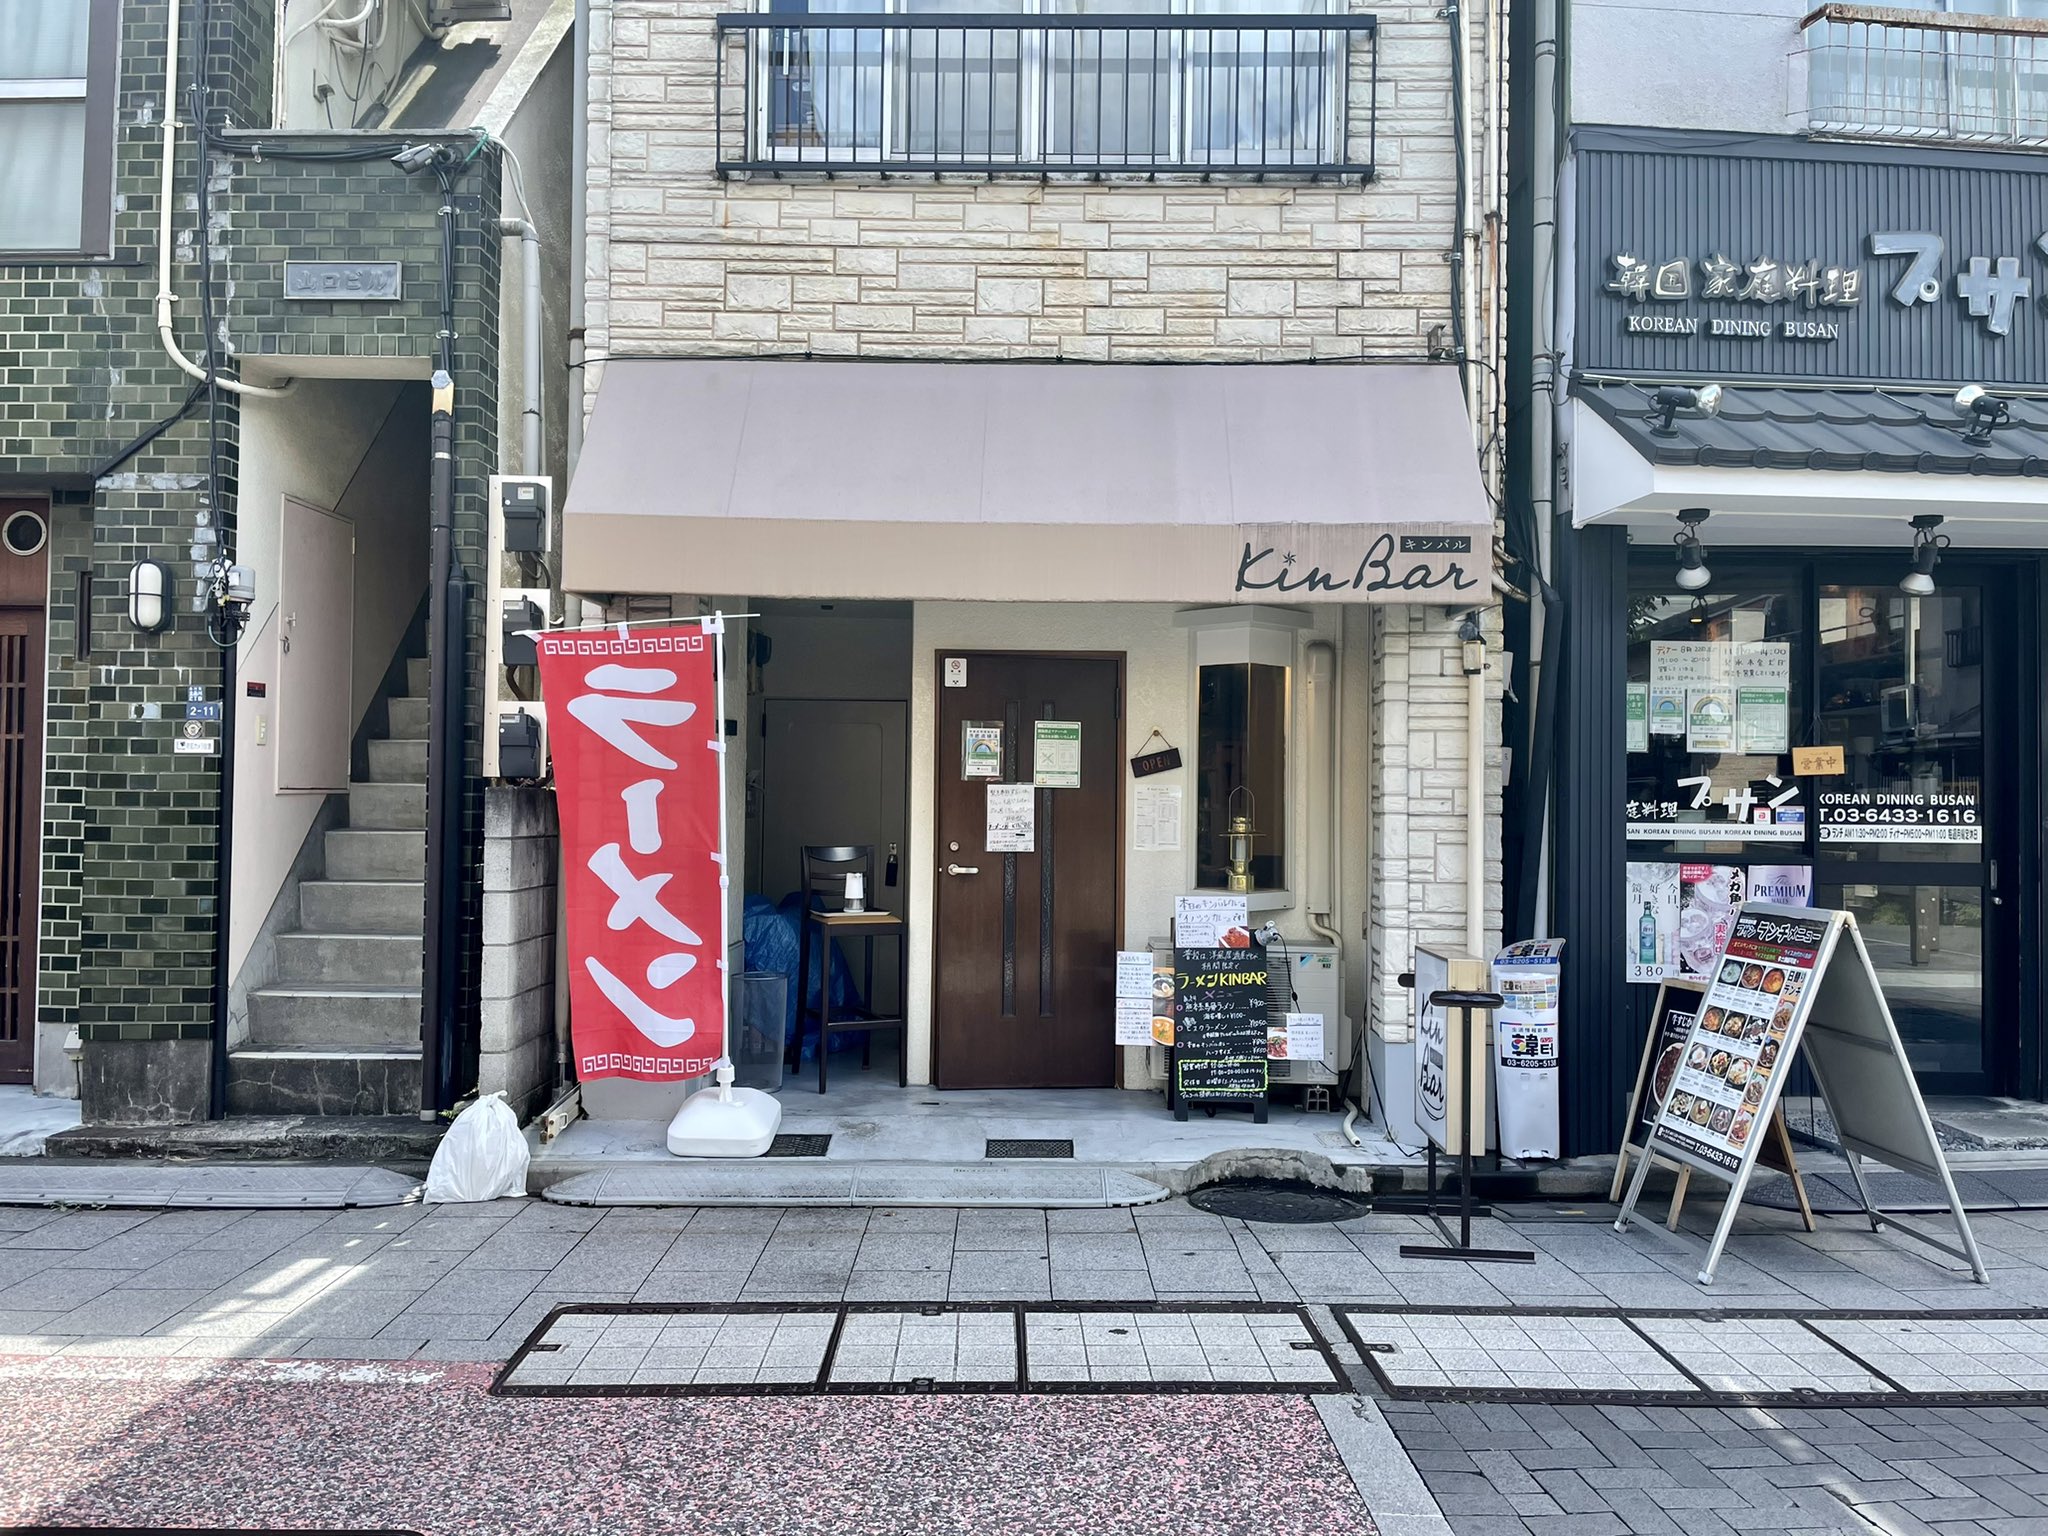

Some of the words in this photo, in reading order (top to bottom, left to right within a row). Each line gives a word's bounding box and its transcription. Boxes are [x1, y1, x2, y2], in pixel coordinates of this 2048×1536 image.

[296, 270, 389, 292] 山口ビル
[1607, 251, 1863, 309] 韓国家庭料理
[1628, 315, 1699, 335] KOREAN
[1711, 318, 1772, 338] DINING
[1783, 321, 1840, 341] BUSAN
[1404, 538, 1467, 550] キンバル
[190, 706, 214, 716] 2-11
[1142, 757, 1171, 772] OPEN
[1677, 774, 1800, 822] プサン
[1876, 794, 1924, 805] DINING
[1930, 794, 1975, 806] BUSAN
[1698, 828, 1722, 836] BUSAN
[567, 664, 704, 1049] ラーメン
[1632, 883, 1642, 904] 鏡月
[1754, 884, 1806, 898] PREMIUM
[1757, 921, 1822, 943] ランチメニュー
[1176, 971, 1268, 990] ラーメンKINBAR
[1634, 965, 1663, 977] 380
[1420, 1042, 1444, 1103] Bar
[1506, 1058, 1557, 1068] 03-6205-5138
